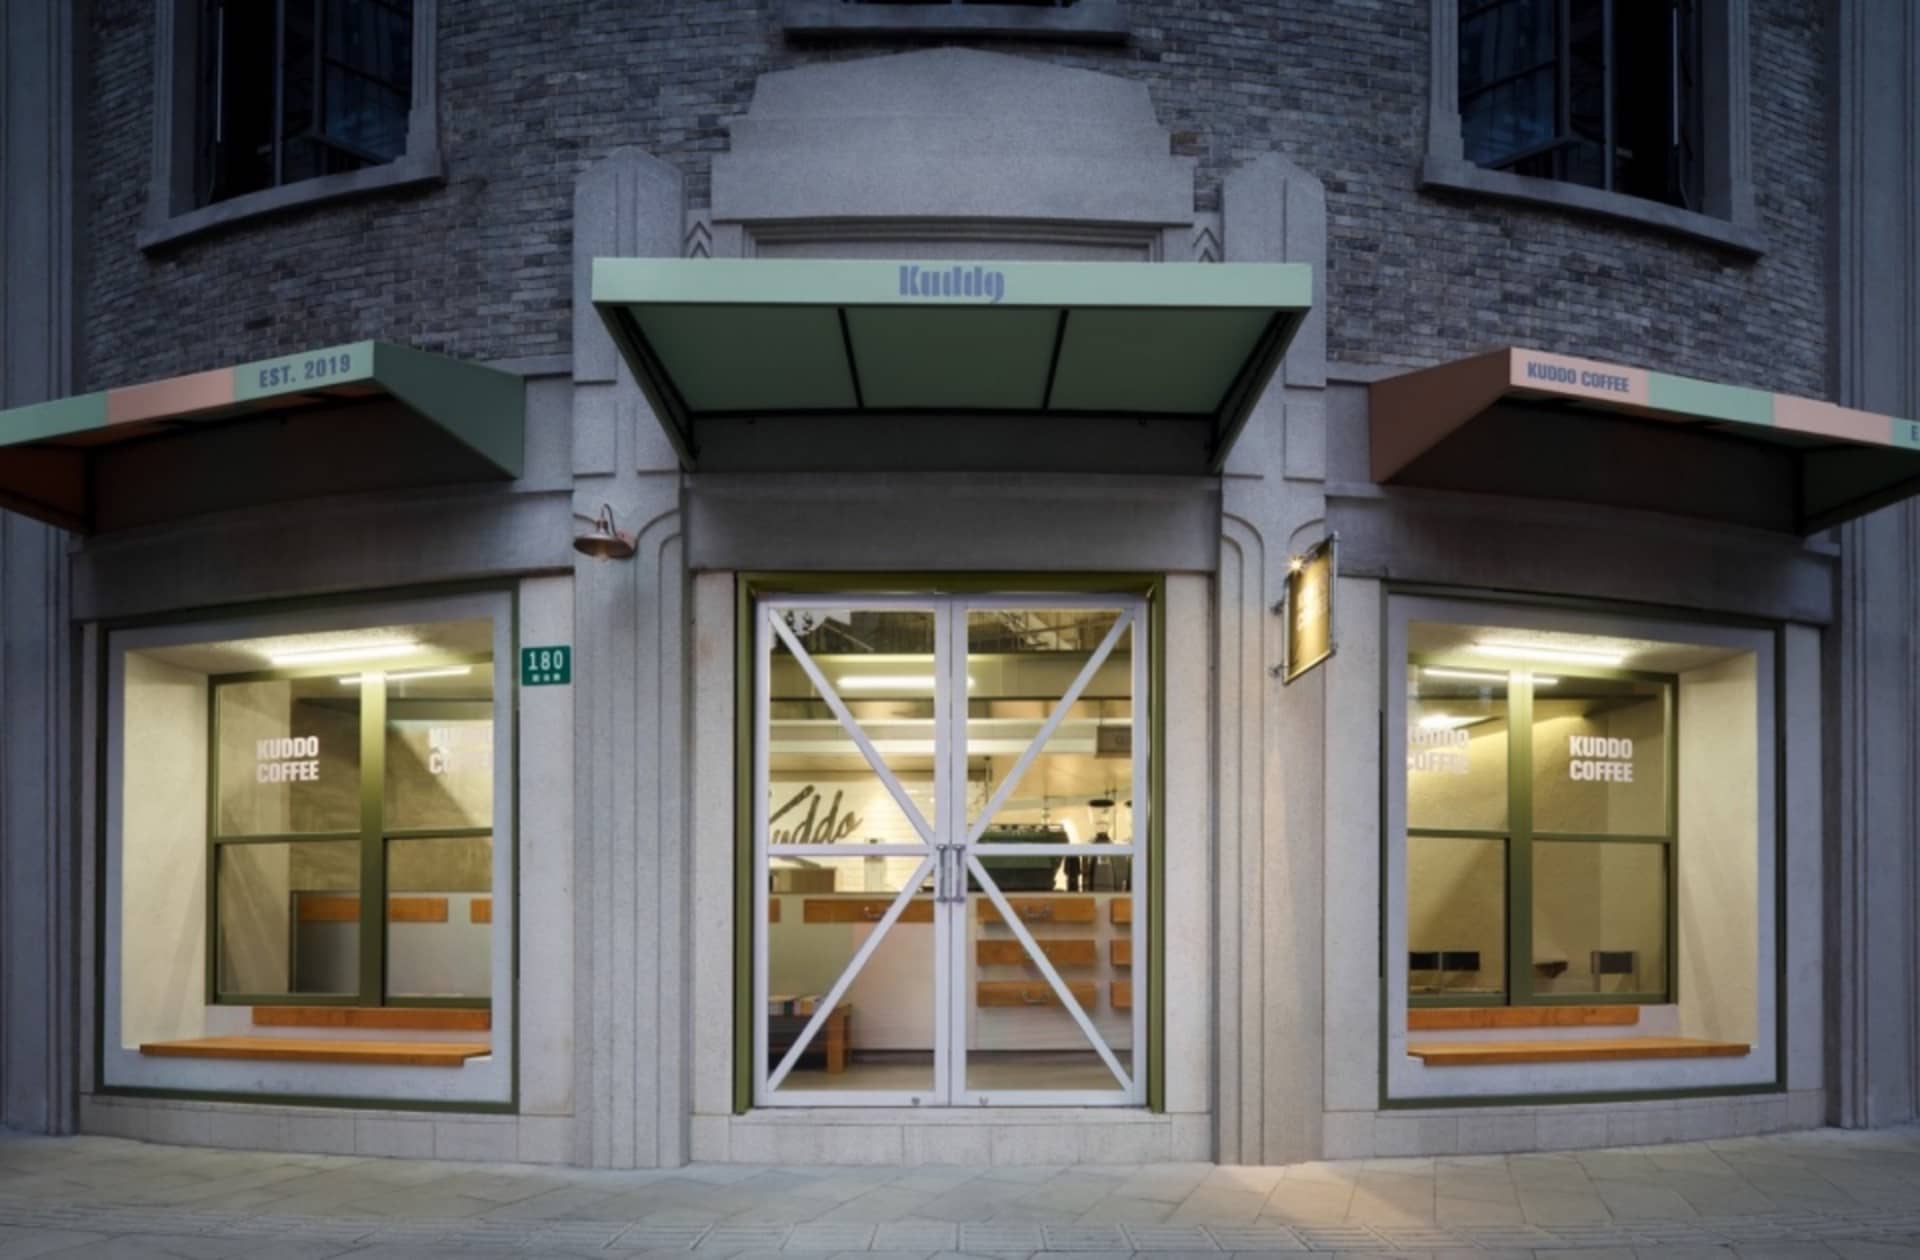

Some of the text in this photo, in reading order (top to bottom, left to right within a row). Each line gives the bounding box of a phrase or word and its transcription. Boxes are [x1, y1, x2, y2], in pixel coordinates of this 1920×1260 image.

[259, 353, 351, 388] EST. 2019
[1527, 361, 1631, 393] KUDDO COFFEE
[528, 649, 563, 671] 180
[256, 736, 319, 760] KUDDO
[1569, 736, 1632, 758] KUDDO
[256, 760, 319, 783] COFFEE
[1569, 760, 1633, 782] COFFEE
